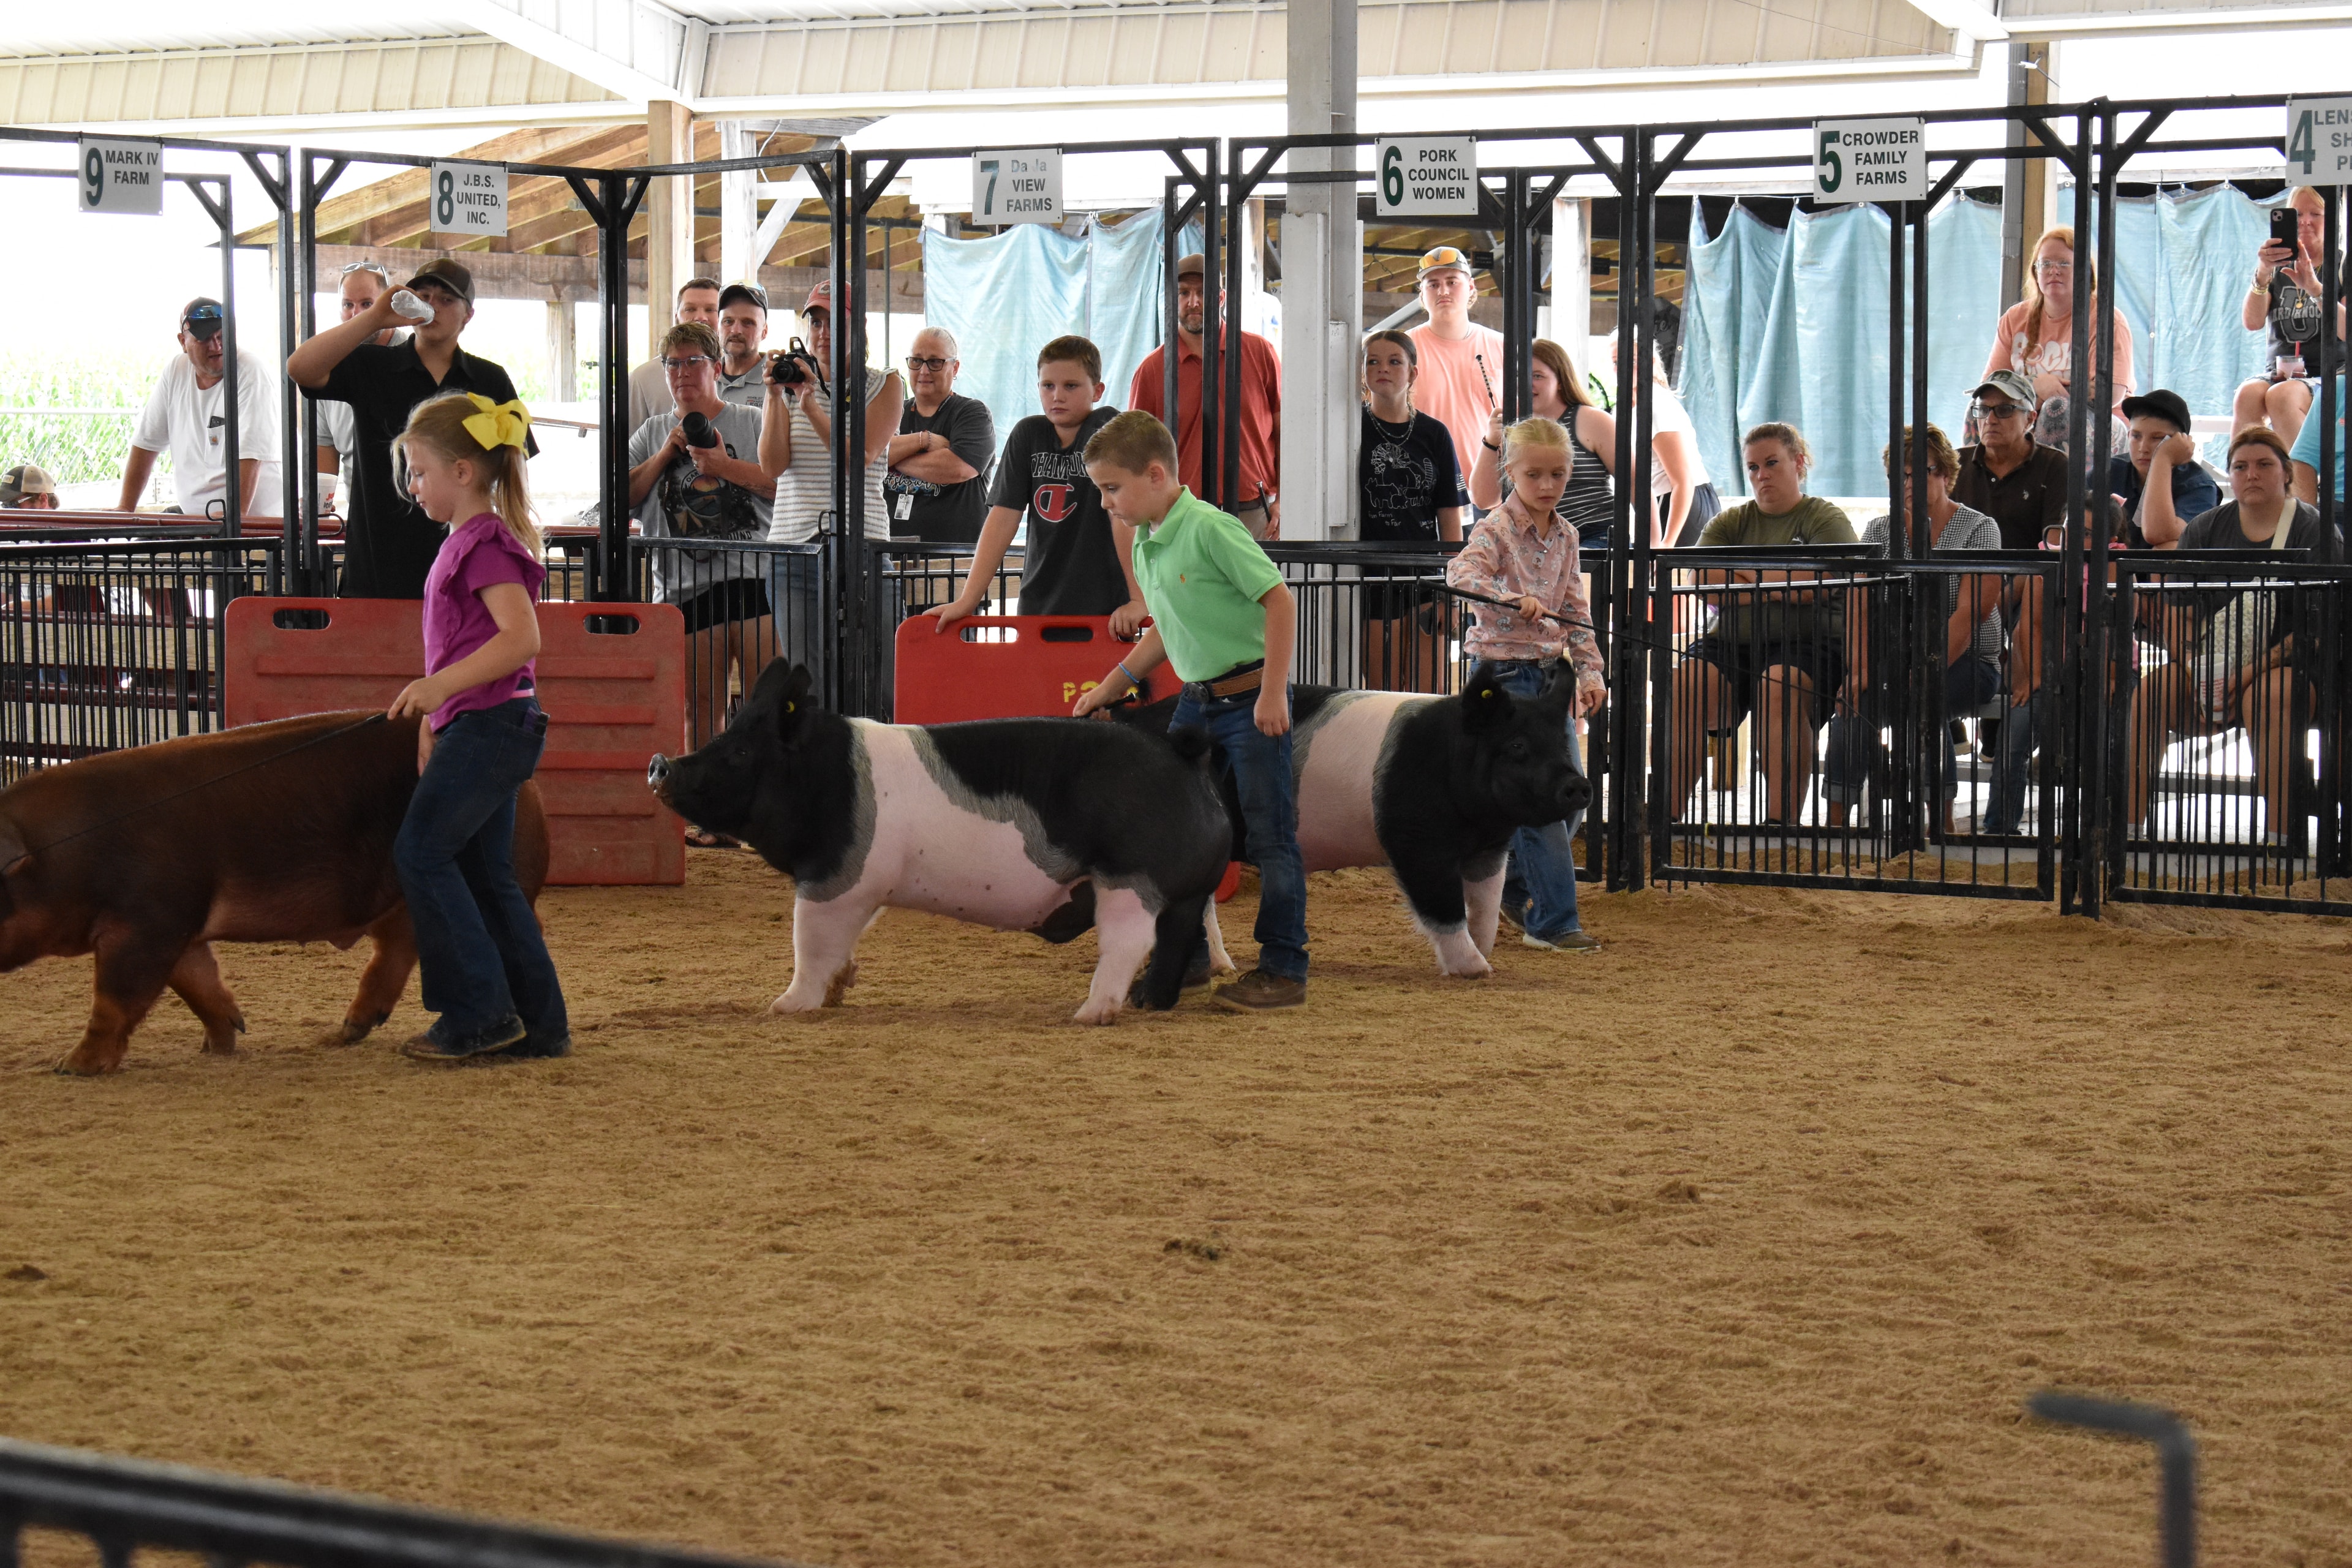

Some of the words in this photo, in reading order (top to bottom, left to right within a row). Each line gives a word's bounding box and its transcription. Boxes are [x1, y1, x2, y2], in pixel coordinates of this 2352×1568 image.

[2315, 110, 2352, 125] LEN
[1842, 130, 1918, 146] CROWDER
[2290, 110, 2315, 175] 4
[105, 150, 143, 165] MARK
[147, 153, 159, 165] IV
[1419, 149, 1457, 162] PORK
[1819, 130, 1842, 193] 5
[1855, 151, 1907, 165] FAMILY
[86, 147, 104, 206] 9
[114, 170, 149, 185] FARM
[464, 173, 494, 188] J.B.S.
[1382, 145, 1403, 206] 6
[1408, 168, 1469, 181] COUNCIL
[1856, 170, 1907, 185] FARMS
[981, 160, 999, 215] 7
[1012, 178, 1046, 192] VIEW
[437, 170, 454, 225] 8
[456, 192, 500, 209] UNITED,
[1412, 187, 1464, 199] WOMEN
[1006, 198, 1052, 212] FARMS
[467, 211, 489, 224] INC.
